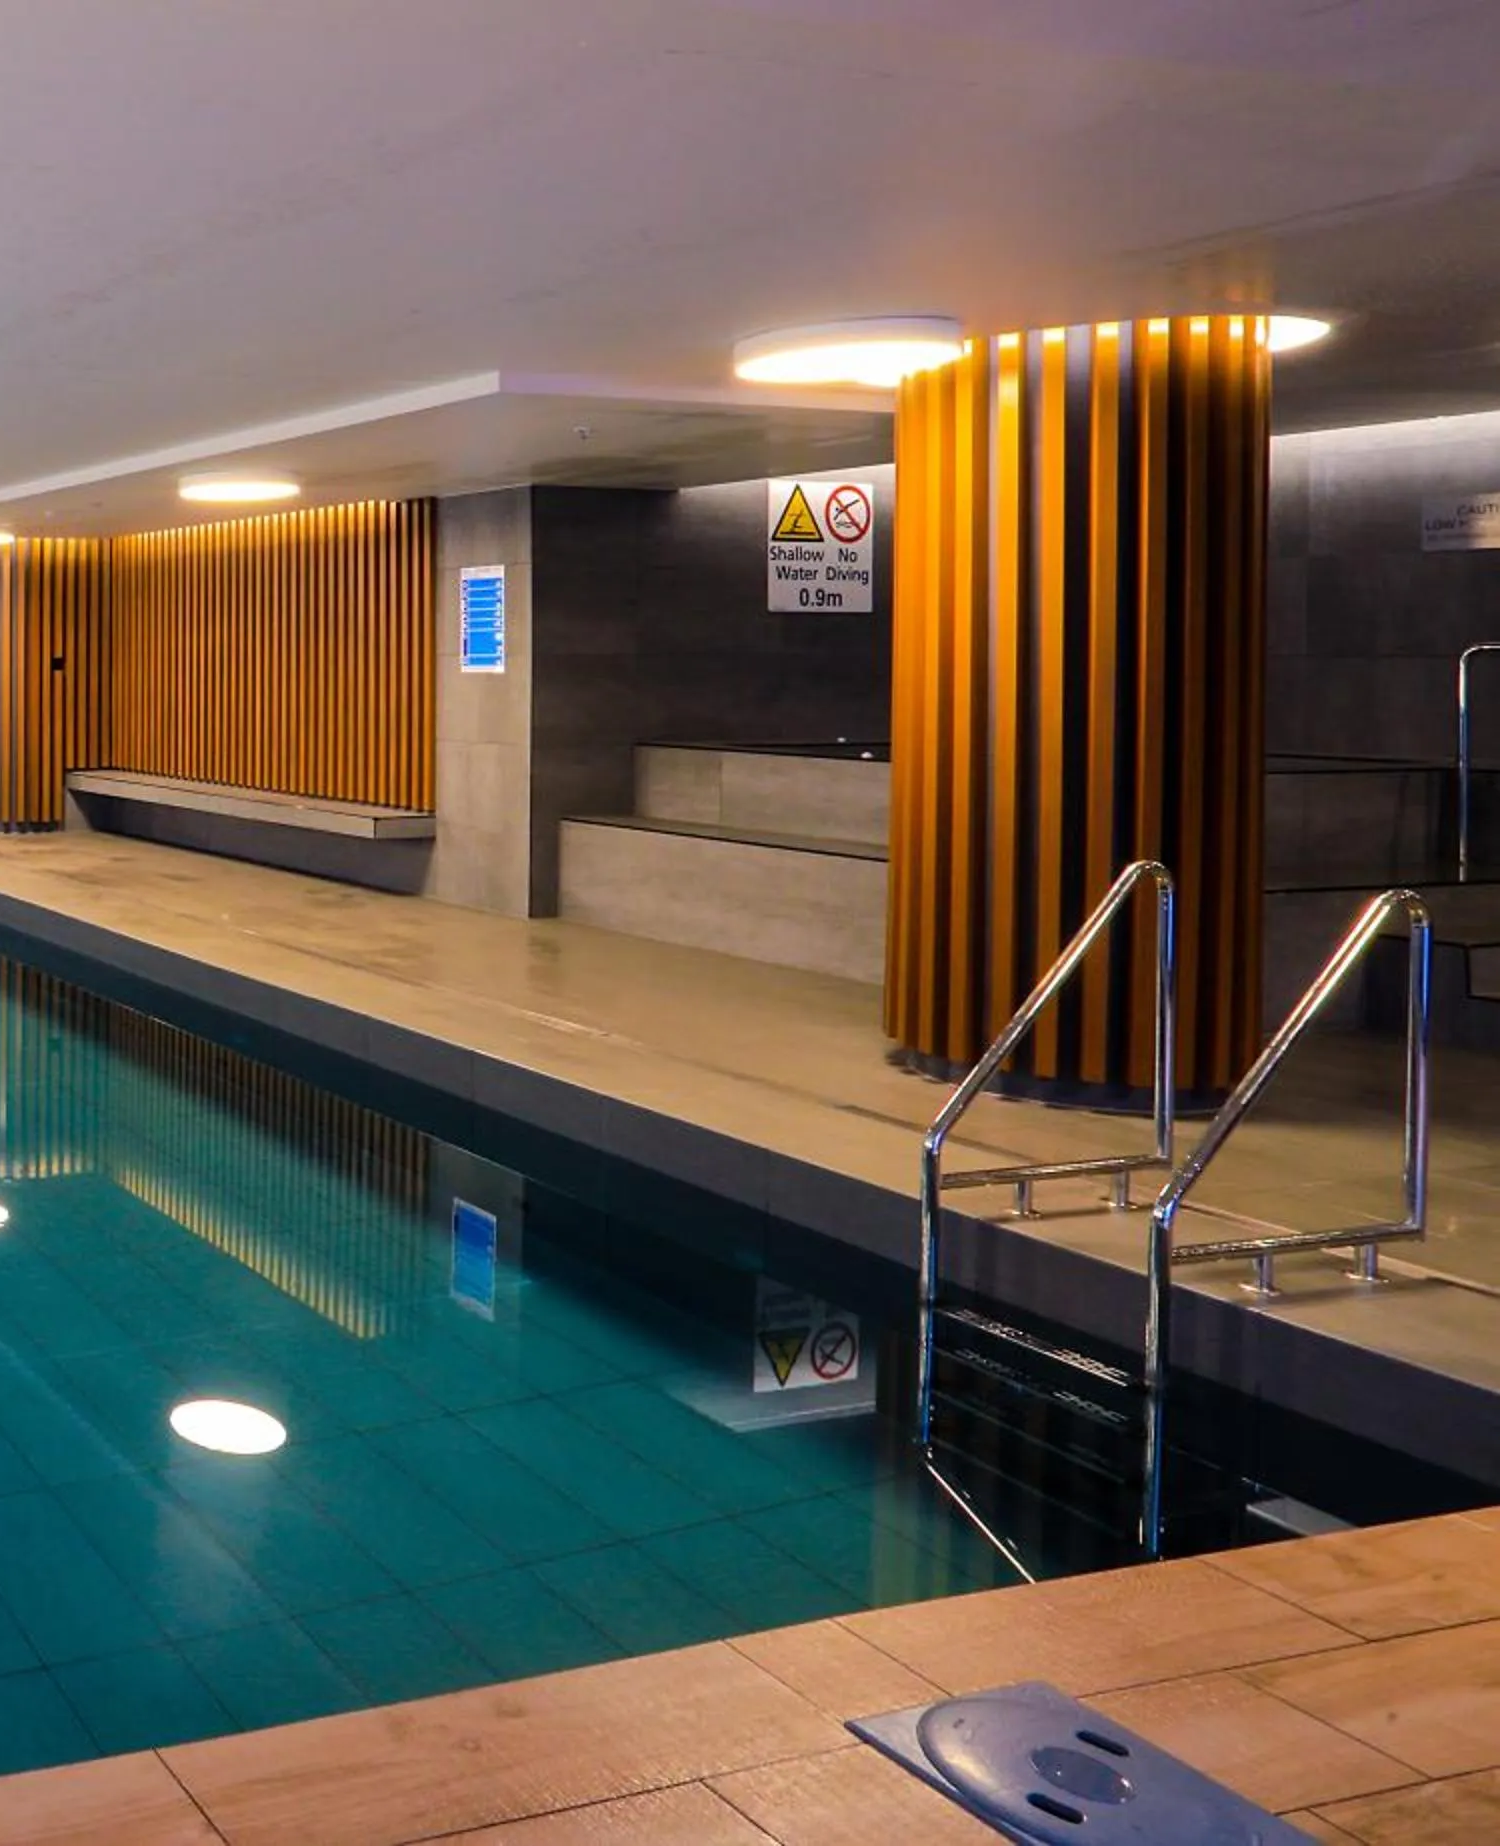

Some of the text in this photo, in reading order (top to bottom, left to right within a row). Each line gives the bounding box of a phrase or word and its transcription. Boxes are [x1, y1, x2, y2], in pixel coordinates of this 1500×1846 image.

[770, 545, 824, 562] Shallow
[838, 548, 858, 563] No
[775, 566, 818, 581] Water
[825, 566, 869, 585] Diving
[799, 588, 843, 607] 0.9m
